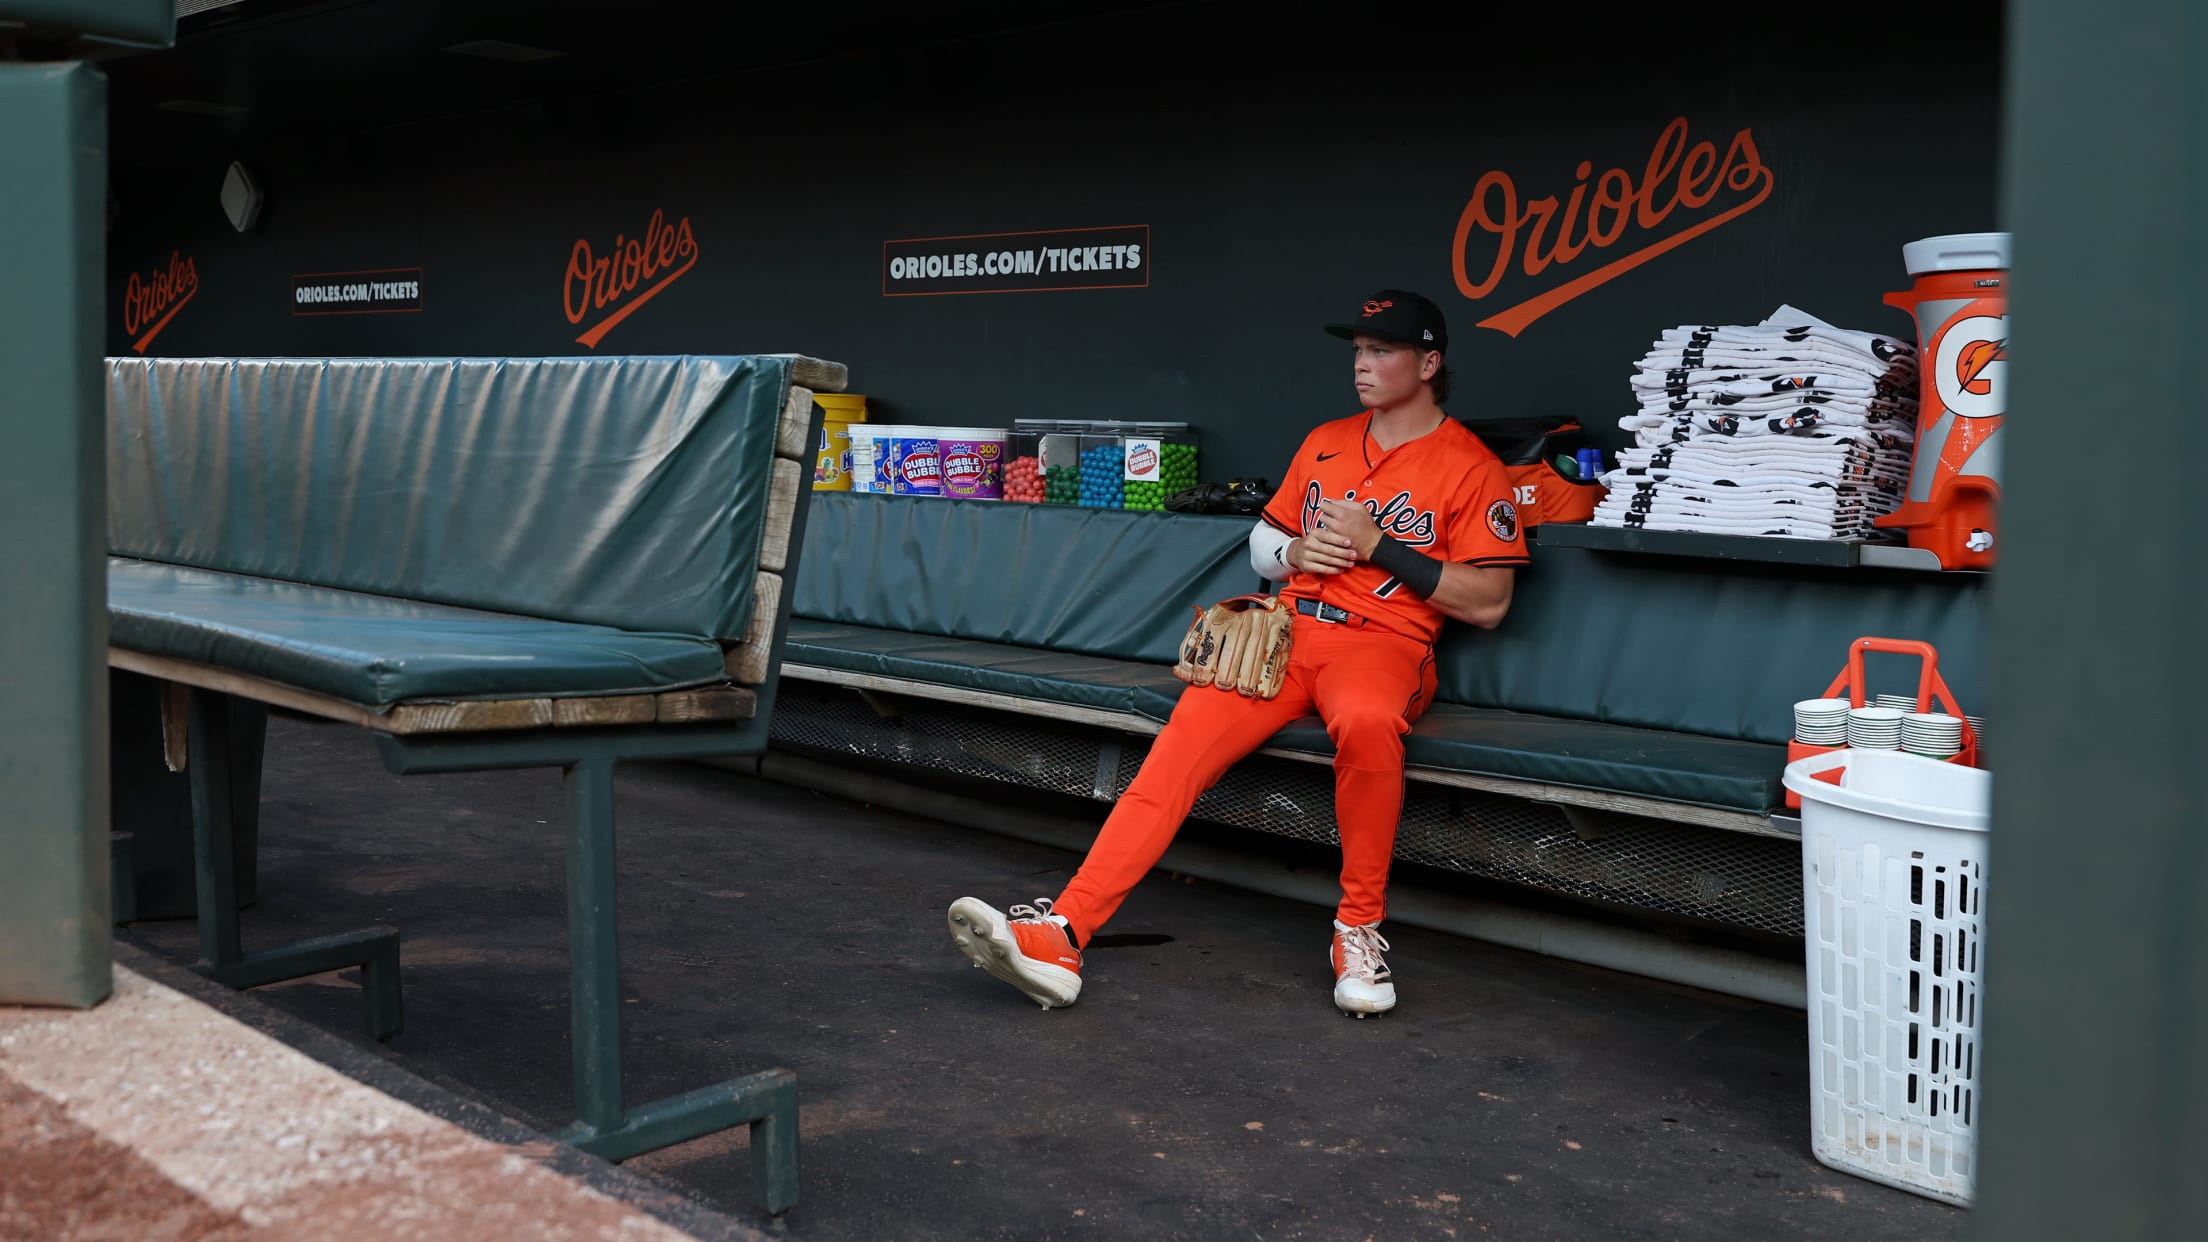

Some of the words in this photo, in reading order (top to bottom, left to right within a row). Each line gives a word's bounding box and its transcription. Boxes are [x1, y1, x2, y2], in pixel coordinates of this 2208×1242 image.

[1452, 116, 1774, 338] Orioles
[890, 245, 1141, 280] ORIOLES.COM/TICKETS
[295, 281, 419, 304] ORIOLES.COM/TICKETS
[563, 207, 699, 349] Orioles
[125, 249, 199, 354] Orioles
[905, 457, 939, 470] DUBBL
[945, 457, 980, 469] DUBBLE
[980, 444, 998, 454] 300
[947, 465, 982, 477] BUBBLE
[1302, 479, 1436, 547] Ooles
